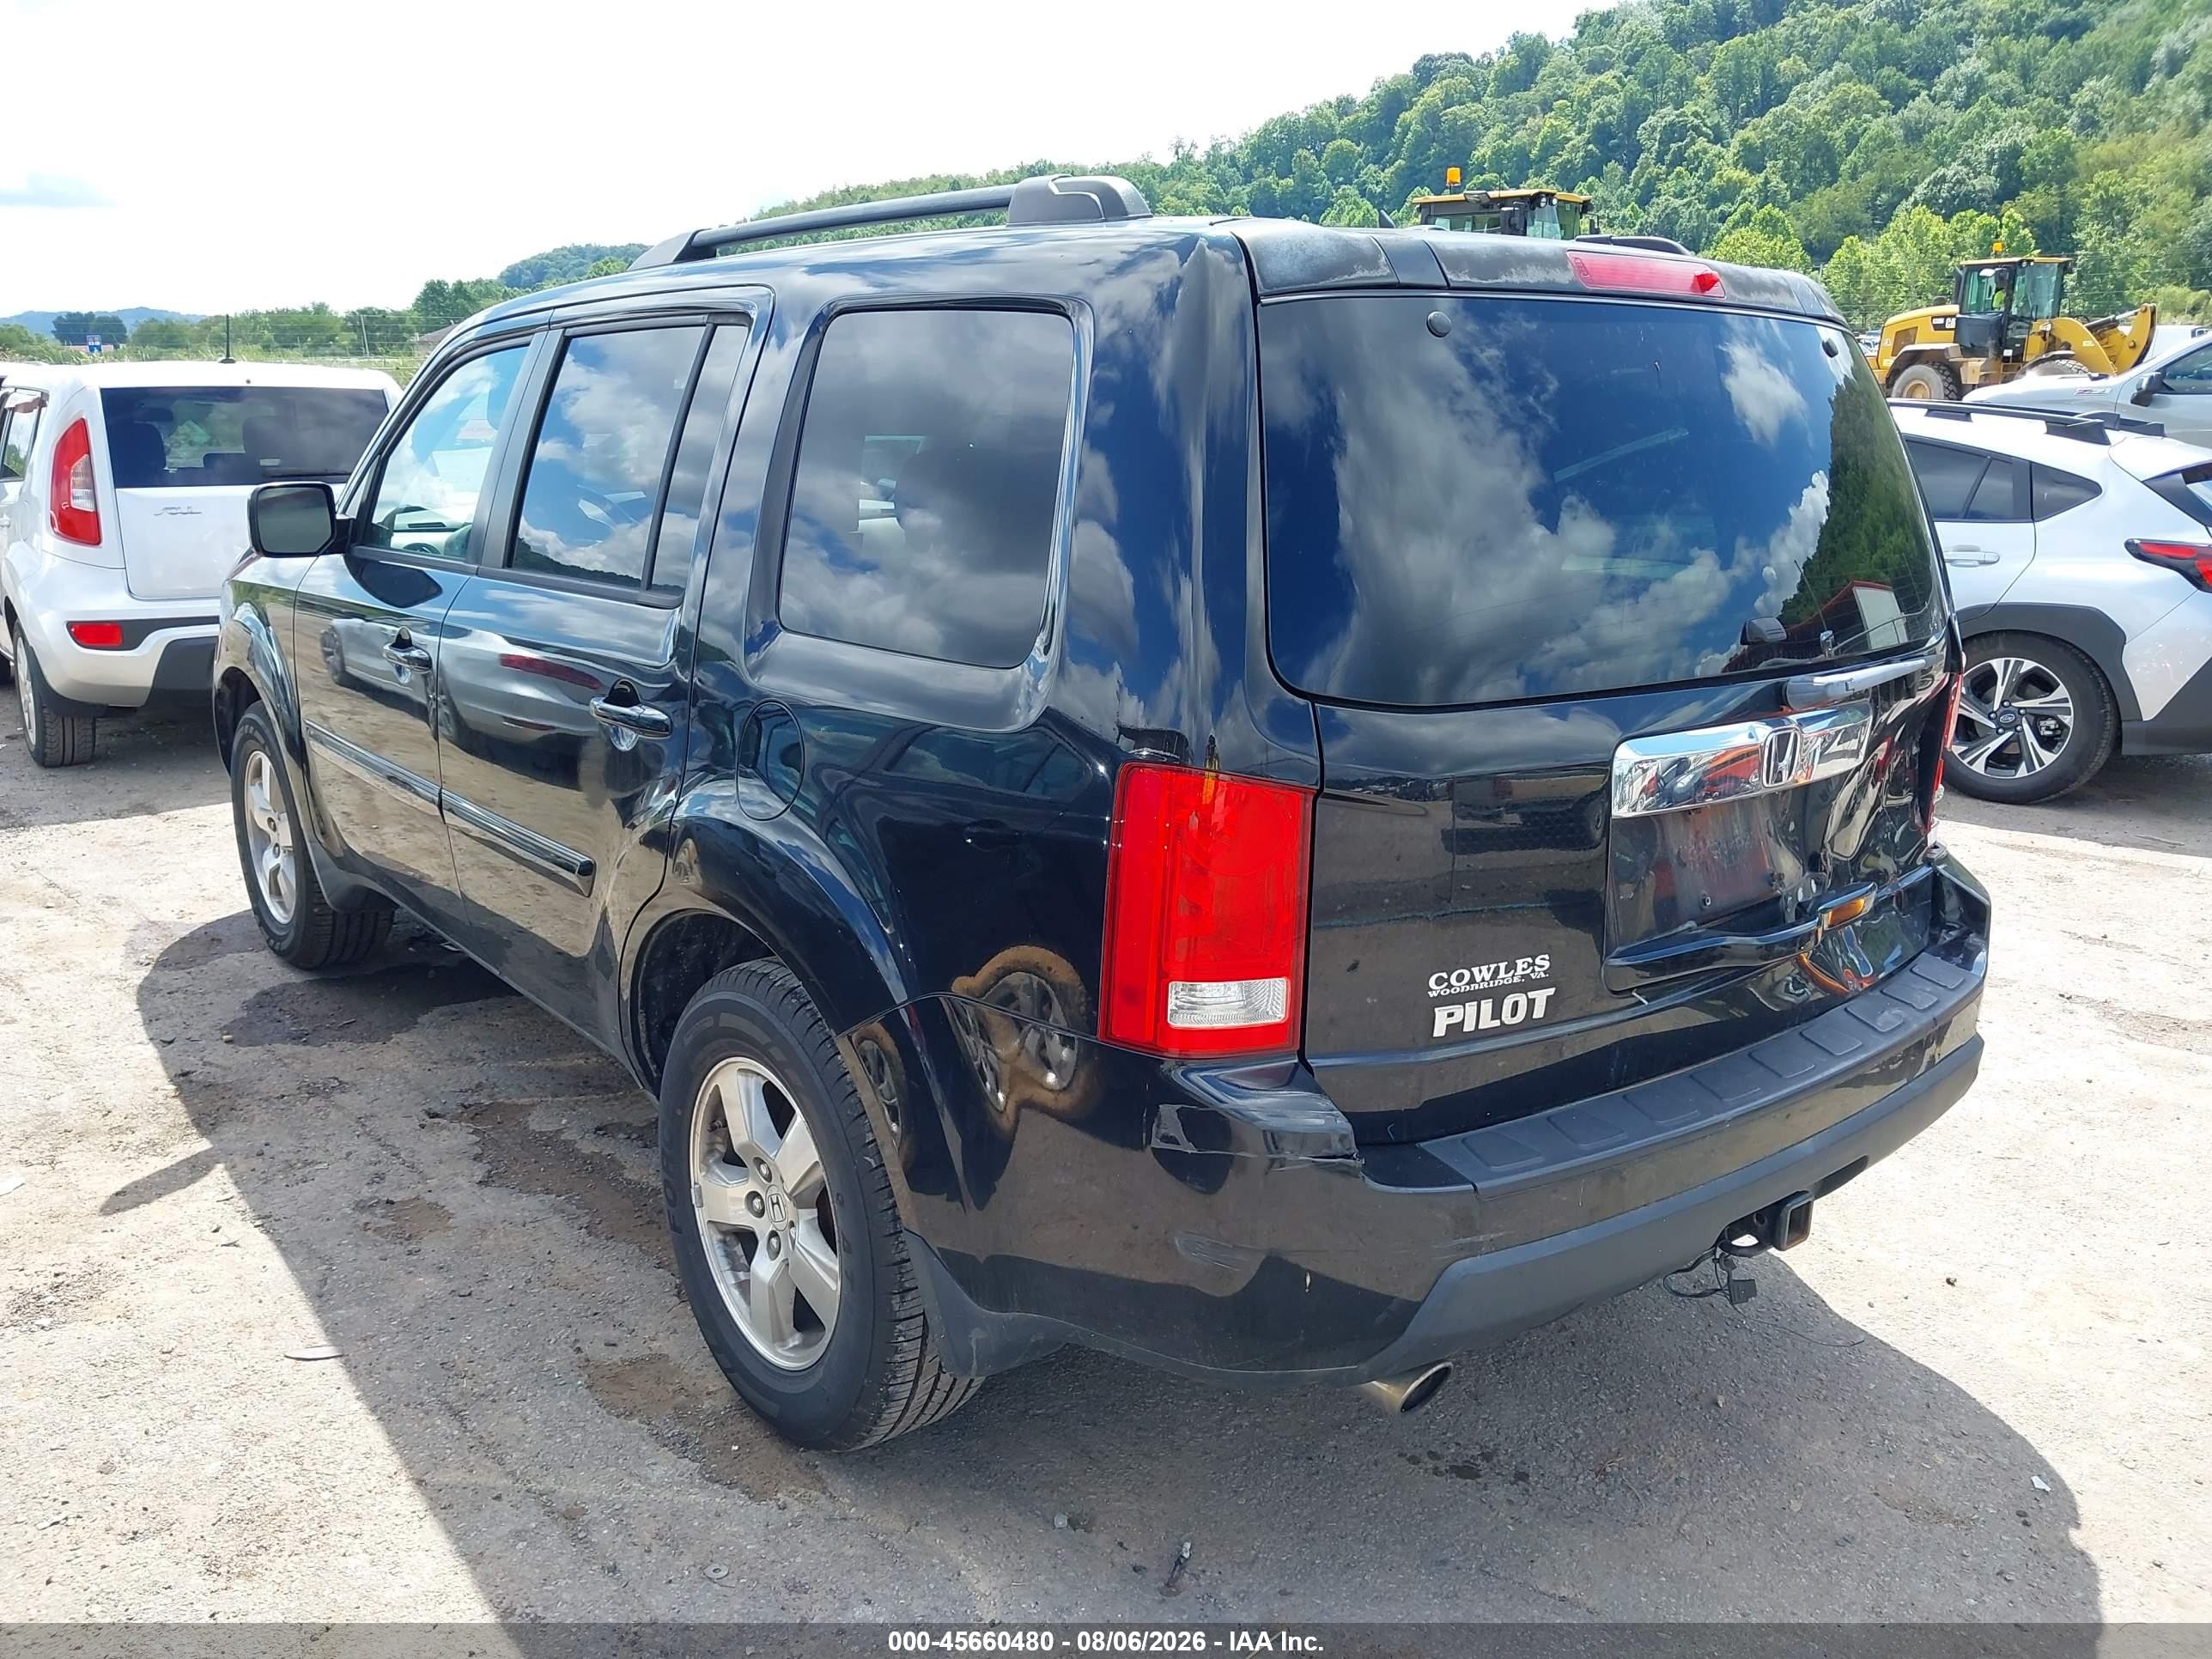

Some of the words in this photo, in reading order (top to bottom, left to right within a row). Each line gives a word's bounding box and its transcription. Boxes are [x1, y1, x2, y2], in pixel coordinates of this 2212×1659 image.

[1428, 954, 1551, 991] COWLES
[1528, 971, 1550, 980] VA.
[1432, 988, 1556, 1038] PILOT
